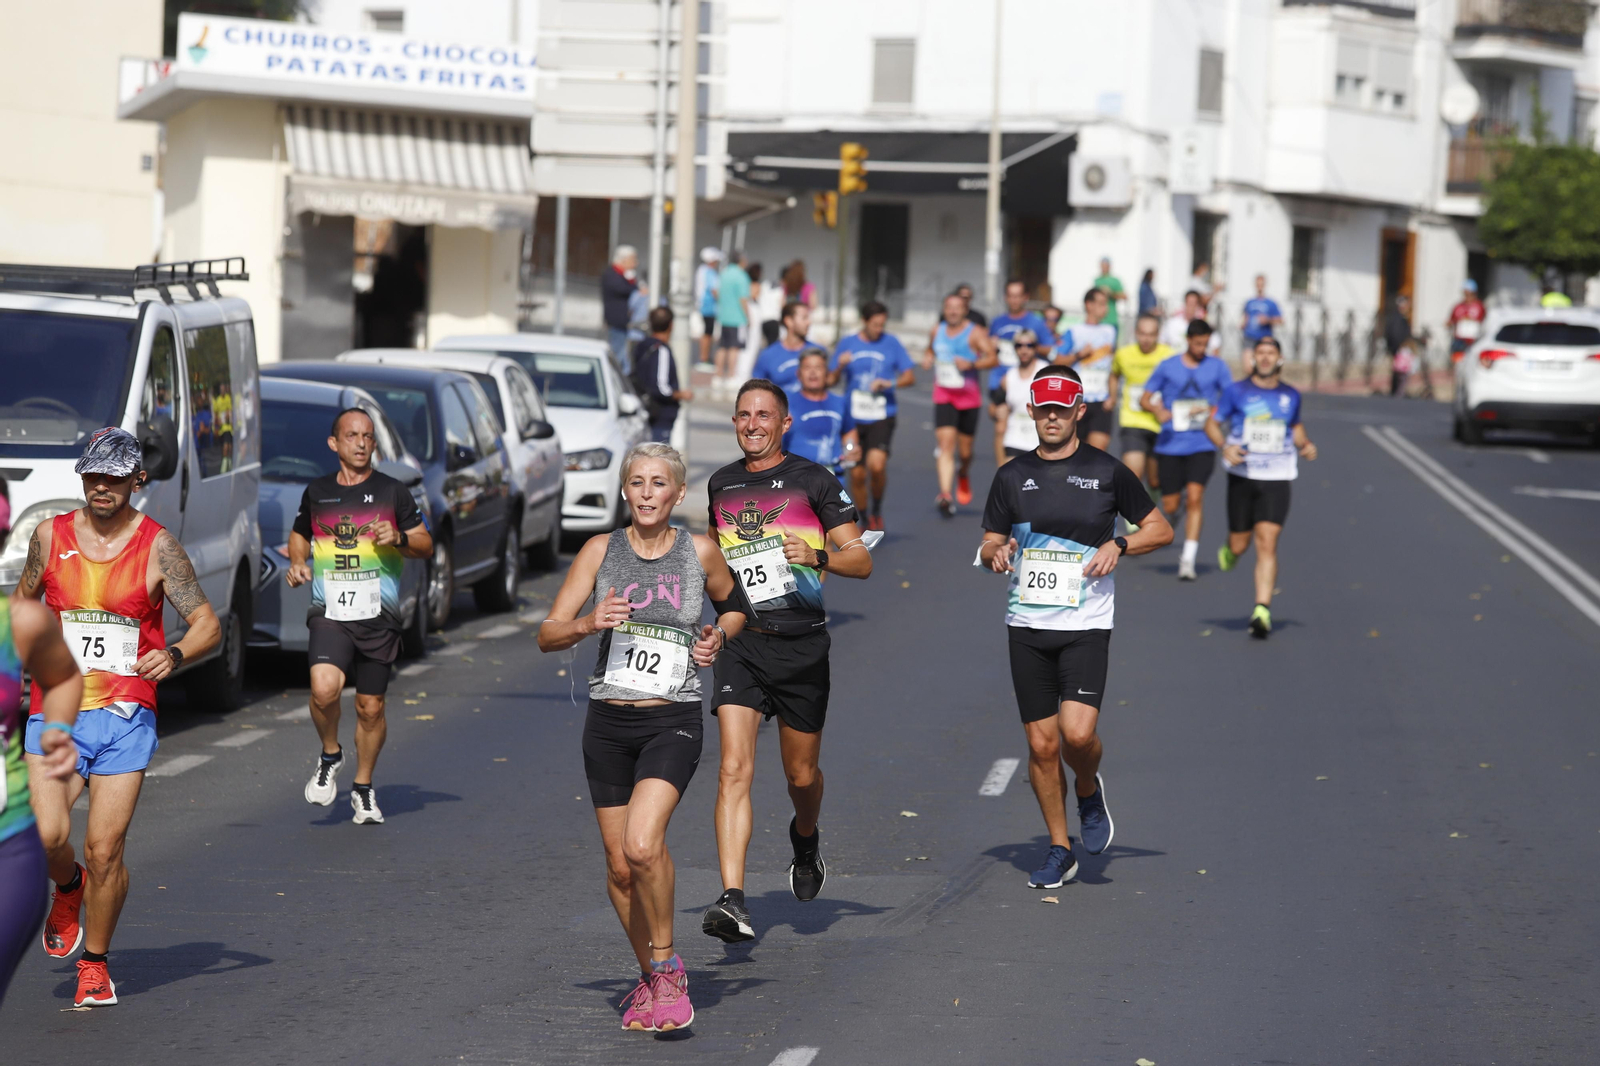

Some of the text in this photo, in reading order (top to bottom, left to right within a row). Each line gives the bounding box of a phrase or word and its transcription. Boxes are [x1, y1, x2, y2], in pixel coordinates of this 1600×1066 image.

[224, 25, 371, 55] CHURROS
[266, 55, 527, 92] PATATAS FRITAS
[750, 544, 756, 554] A
[755, 539, 779, 552] HUELVA
[335, 554, 361, 570] 30
[1030, 551, 1051, 560] VUELTA
[1051, 552, 1056, 561] A
[1056, 553, 1079, 563] HUELVA
[333, 572, 353, 581] VUELTA
[353, 572, 358, 581] A
[358, 570, 377, 580] HUELVA
[658, 574, 680, 583] RUN
[1027, 571, 1058, 590] 269
[338, 591, 357, 607] 47
[623, 583, 681, 610] ON
[77, 612, 101, 623] VUELTA
[102, 613, 107, 623] A
[630, 625, 655, 637] VUELTA
[656, 628, 662, 639] A
[663, 629, 686, 645] HUELVA
[82, 636, 106, 659] 75
[624, 647, 662, 675] 102
